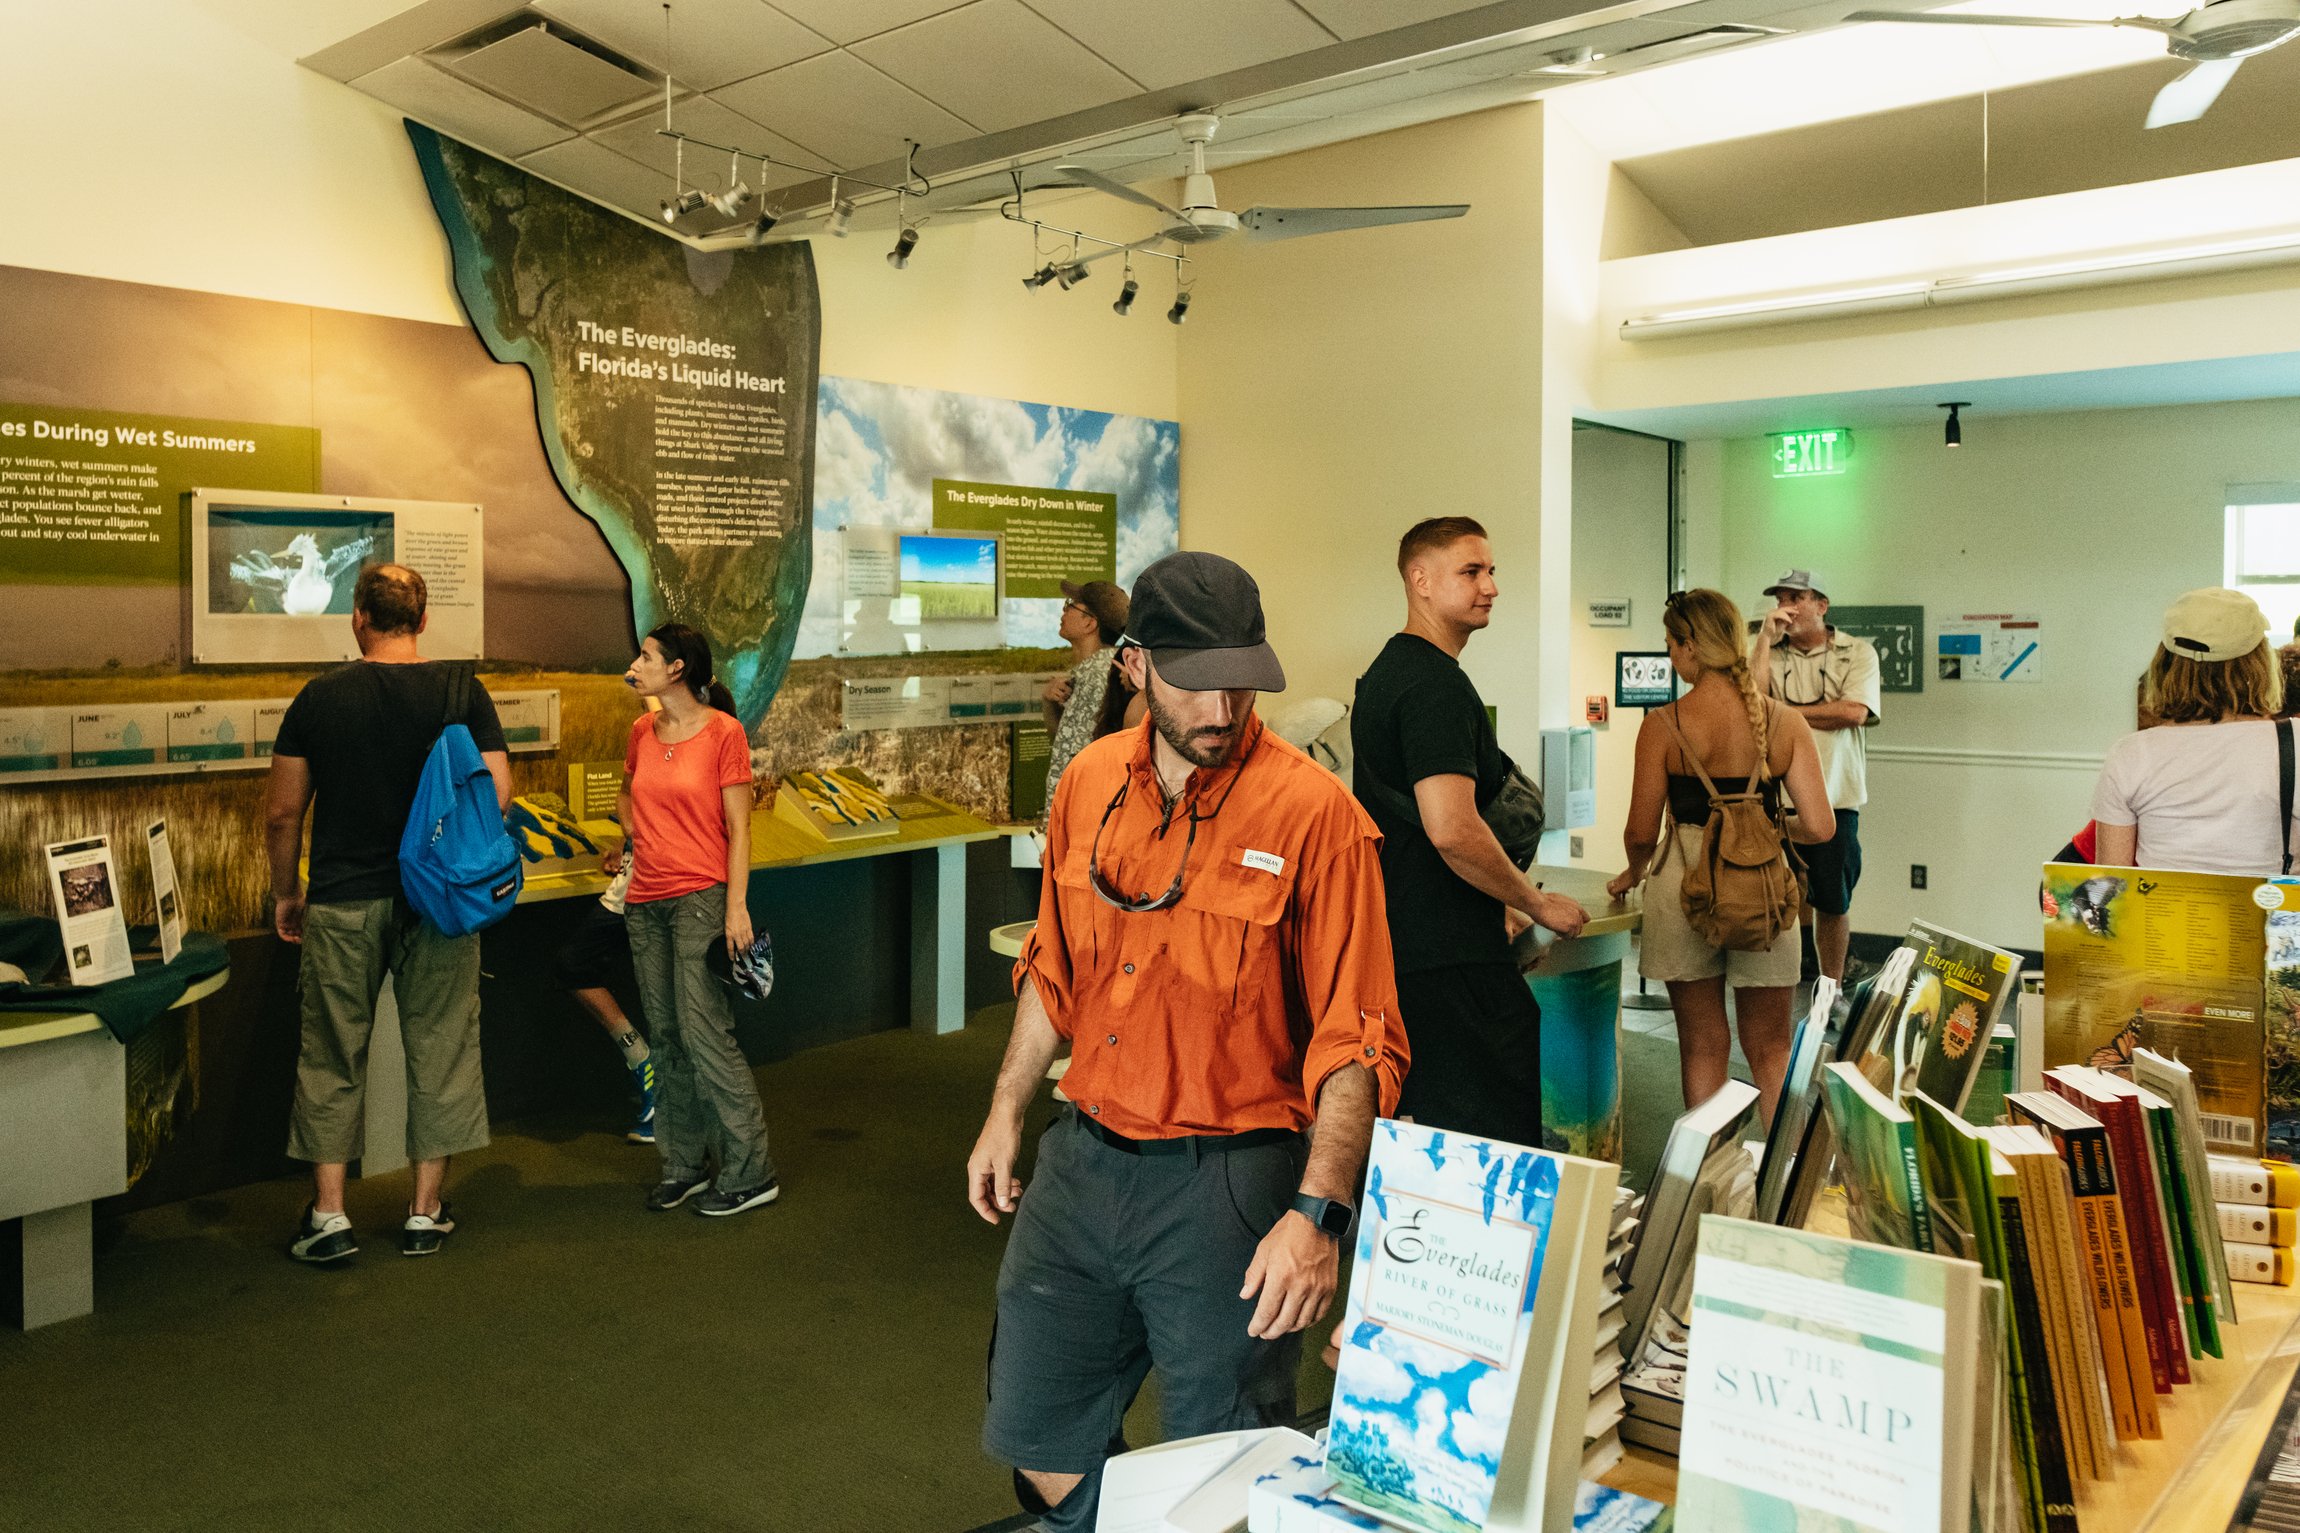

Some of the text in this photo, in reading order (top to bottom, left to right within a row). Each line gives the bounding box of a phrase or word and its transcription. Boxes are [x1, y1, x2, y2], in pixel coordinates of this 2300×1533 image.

[578, 321, 736, 360] The Everglades:
[579, 352, 785, 394] Florida's Liquid Heart
[656, 395, 687, 405] Thousands
[736, 402, 745, 410] the
[701, 421, 712, 430] Dry
[1, 420, 256, 453] es During Wet Summers
[656, 439, 674, 448] things
[720, 444, 742, 453] depend
[1783, 433, 1837, 472] EXIT
[0, 456, 12, 468] ry
[61, 460, 80, 470] wet
[82, 462, 128, 472] summers
[131, 464, 158, 474] make
[2, 471, 159, 488] percent of the region's rain falls
[22, 485, 36, 496] As
[38, 486, 56, 497] the
[58, 488, 90, 499] marsh
[92, 490, 108, 502] get
[110, 490, 144, 502] wetter,
[947, 490, 1103, 512] The Everglades Dry Down in Winter
[12, 500, 74, 512] populations
[76, 501, 112, 513] bounce
[143, 505, 162, 515] and
[710, 506, 734, 515] through
[0, 512, 150, 530] lades. You see fewer alligators
[1, 528, 160, 542] out and stay cool underwater in
[849, 685, 891, 696] Dry Season
[1923, 946, 1985, 986] Everglades
[2205, 1007, 2226, 1016] EVEN
[2082, 1201, 2100, 1252] EVERGLADES
[2103, 1200, 2122, 1250] EVERGLADES
[1383, 1209, 1521, 1289] Everglades
[1430, 1234, 1446, 1246] THE
[1385, 1268, 1507, 1317] RIVER OF GRASS
[1376, 1302, 1415, 1322] MARJORY
[1418, 1314, 1464, 1338] STONEMAN
[1784, 1345, 1844, 1380] THE
[1714, 1361, 1914, 1444] SWAMP
